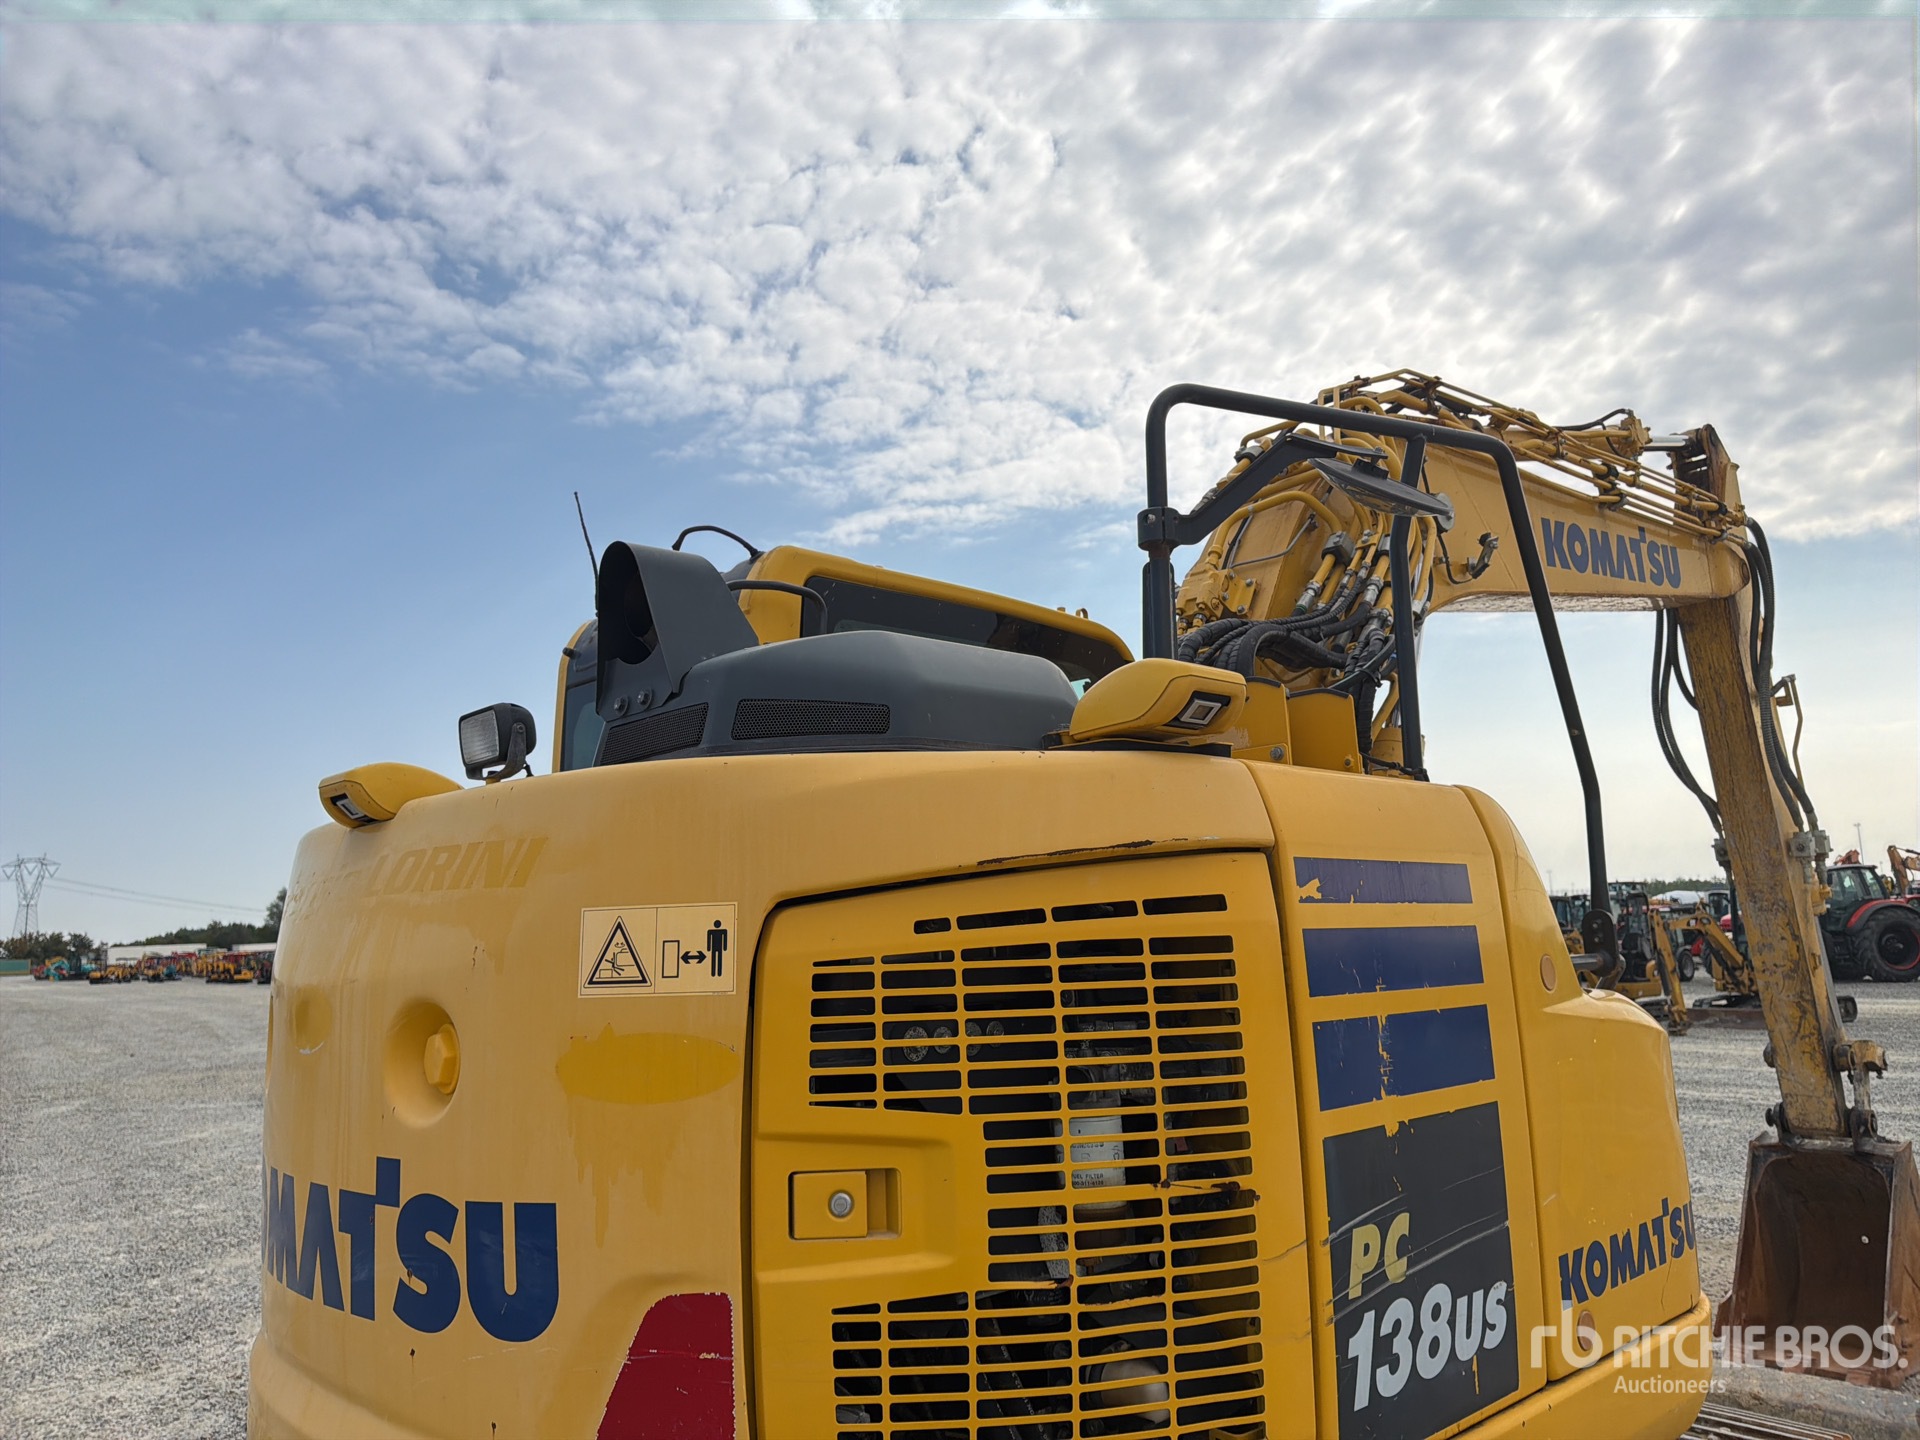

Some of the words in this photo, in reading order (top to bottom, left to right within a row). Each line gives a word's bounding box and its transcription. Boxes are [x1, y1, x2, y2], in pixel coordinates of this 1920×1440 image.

[1541, 517, 1682, 589] KOMATSU
[1348, 1212, 1410, 1300] PC
[1558, 1197, 1696, 1311] KOMATSU
[1348, 1280, 1508, 1412] 138US
